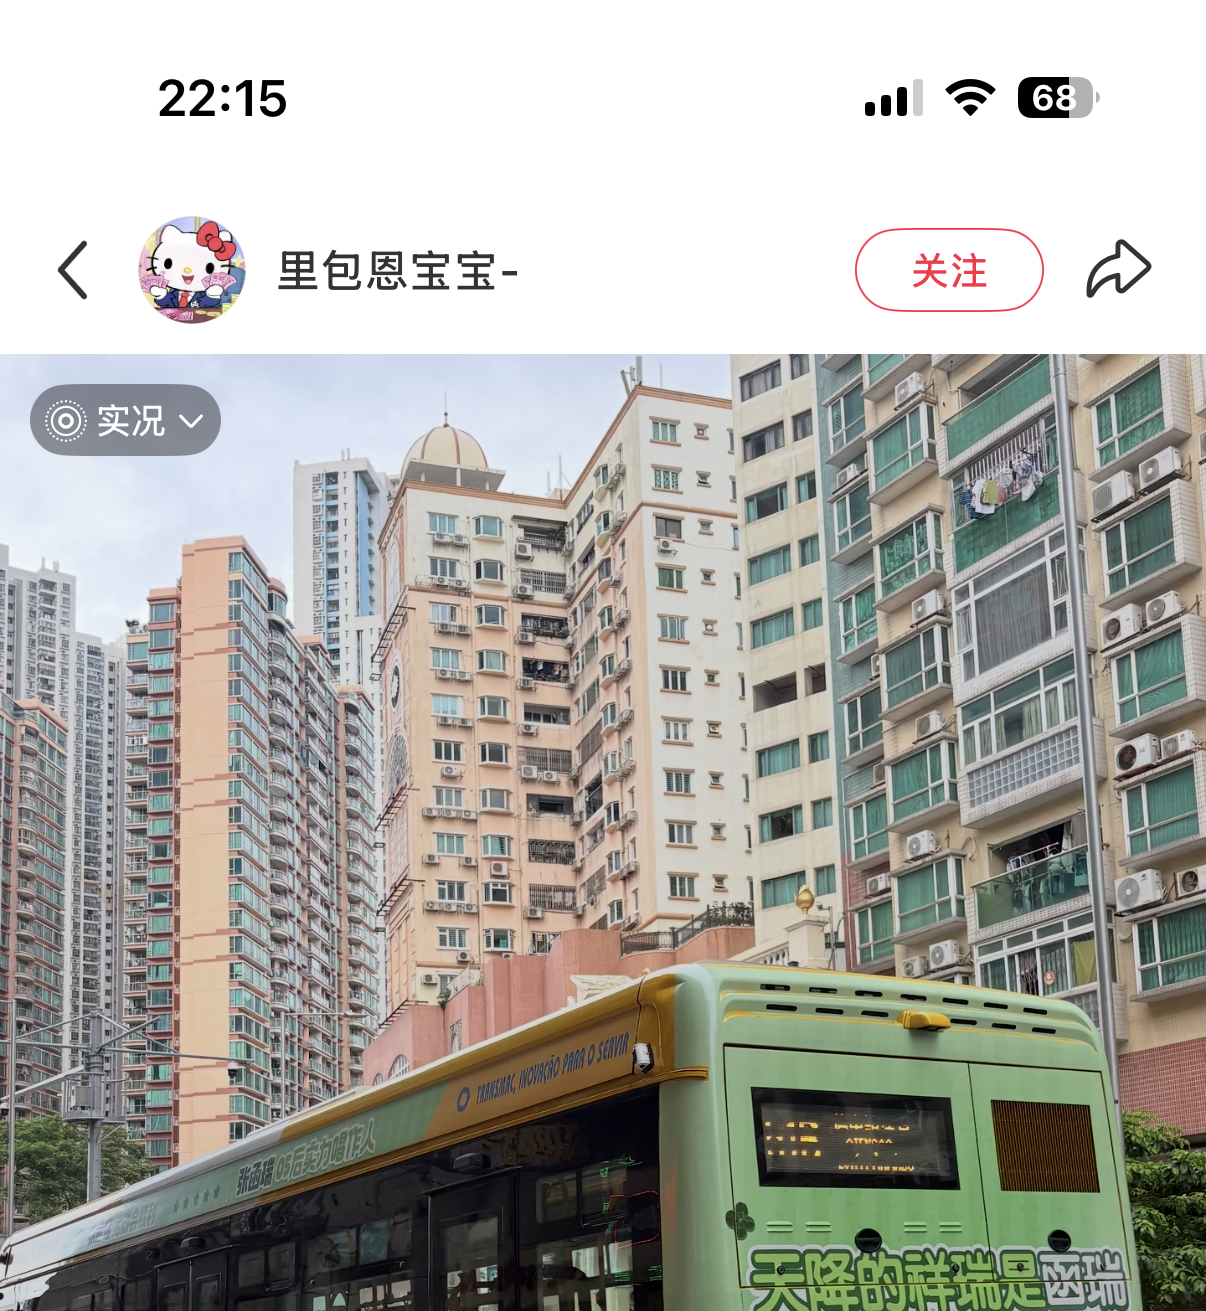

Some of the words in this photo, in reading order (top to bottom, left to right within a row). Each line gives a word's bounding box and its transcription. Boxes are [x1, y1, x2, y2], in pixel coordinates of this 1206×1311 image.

[518, 1055, 560, 1089] INOVAÇÃO
[562, 1048, 586, 1075] PARA
[587, 1044, 595, 1066] O
[597, 1032, 630, 1063] SERVIR
